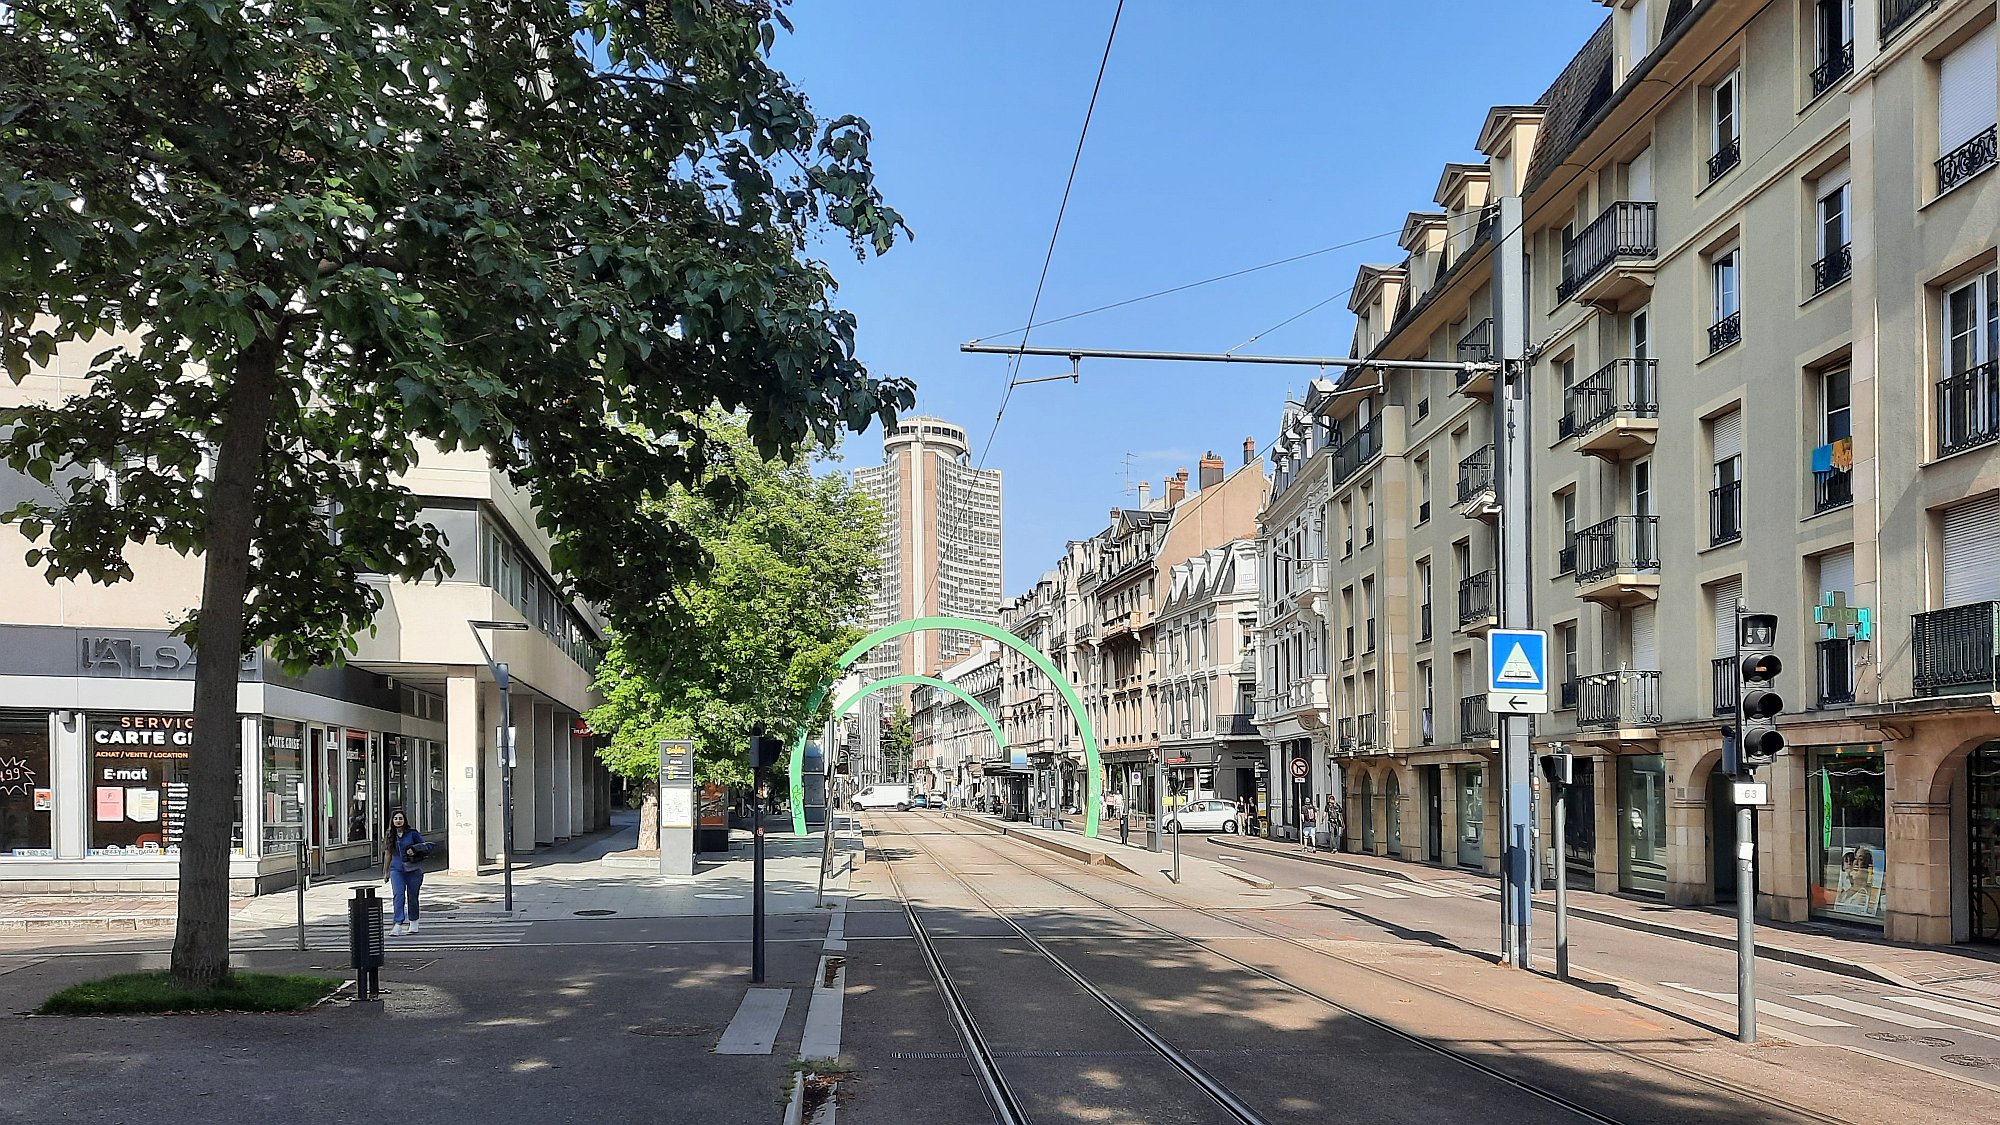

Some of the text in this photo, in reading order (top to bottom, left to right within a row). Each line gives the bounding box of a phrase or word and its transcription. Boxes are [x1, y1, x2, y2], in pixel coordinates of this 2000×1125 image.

[121, 717, 194, 729] SERVIC
[94, 730, 165, 745] CARTE
[267, 735, 301, 750] CARTE GRISE
[1744, 789, 1757, 799] 63
